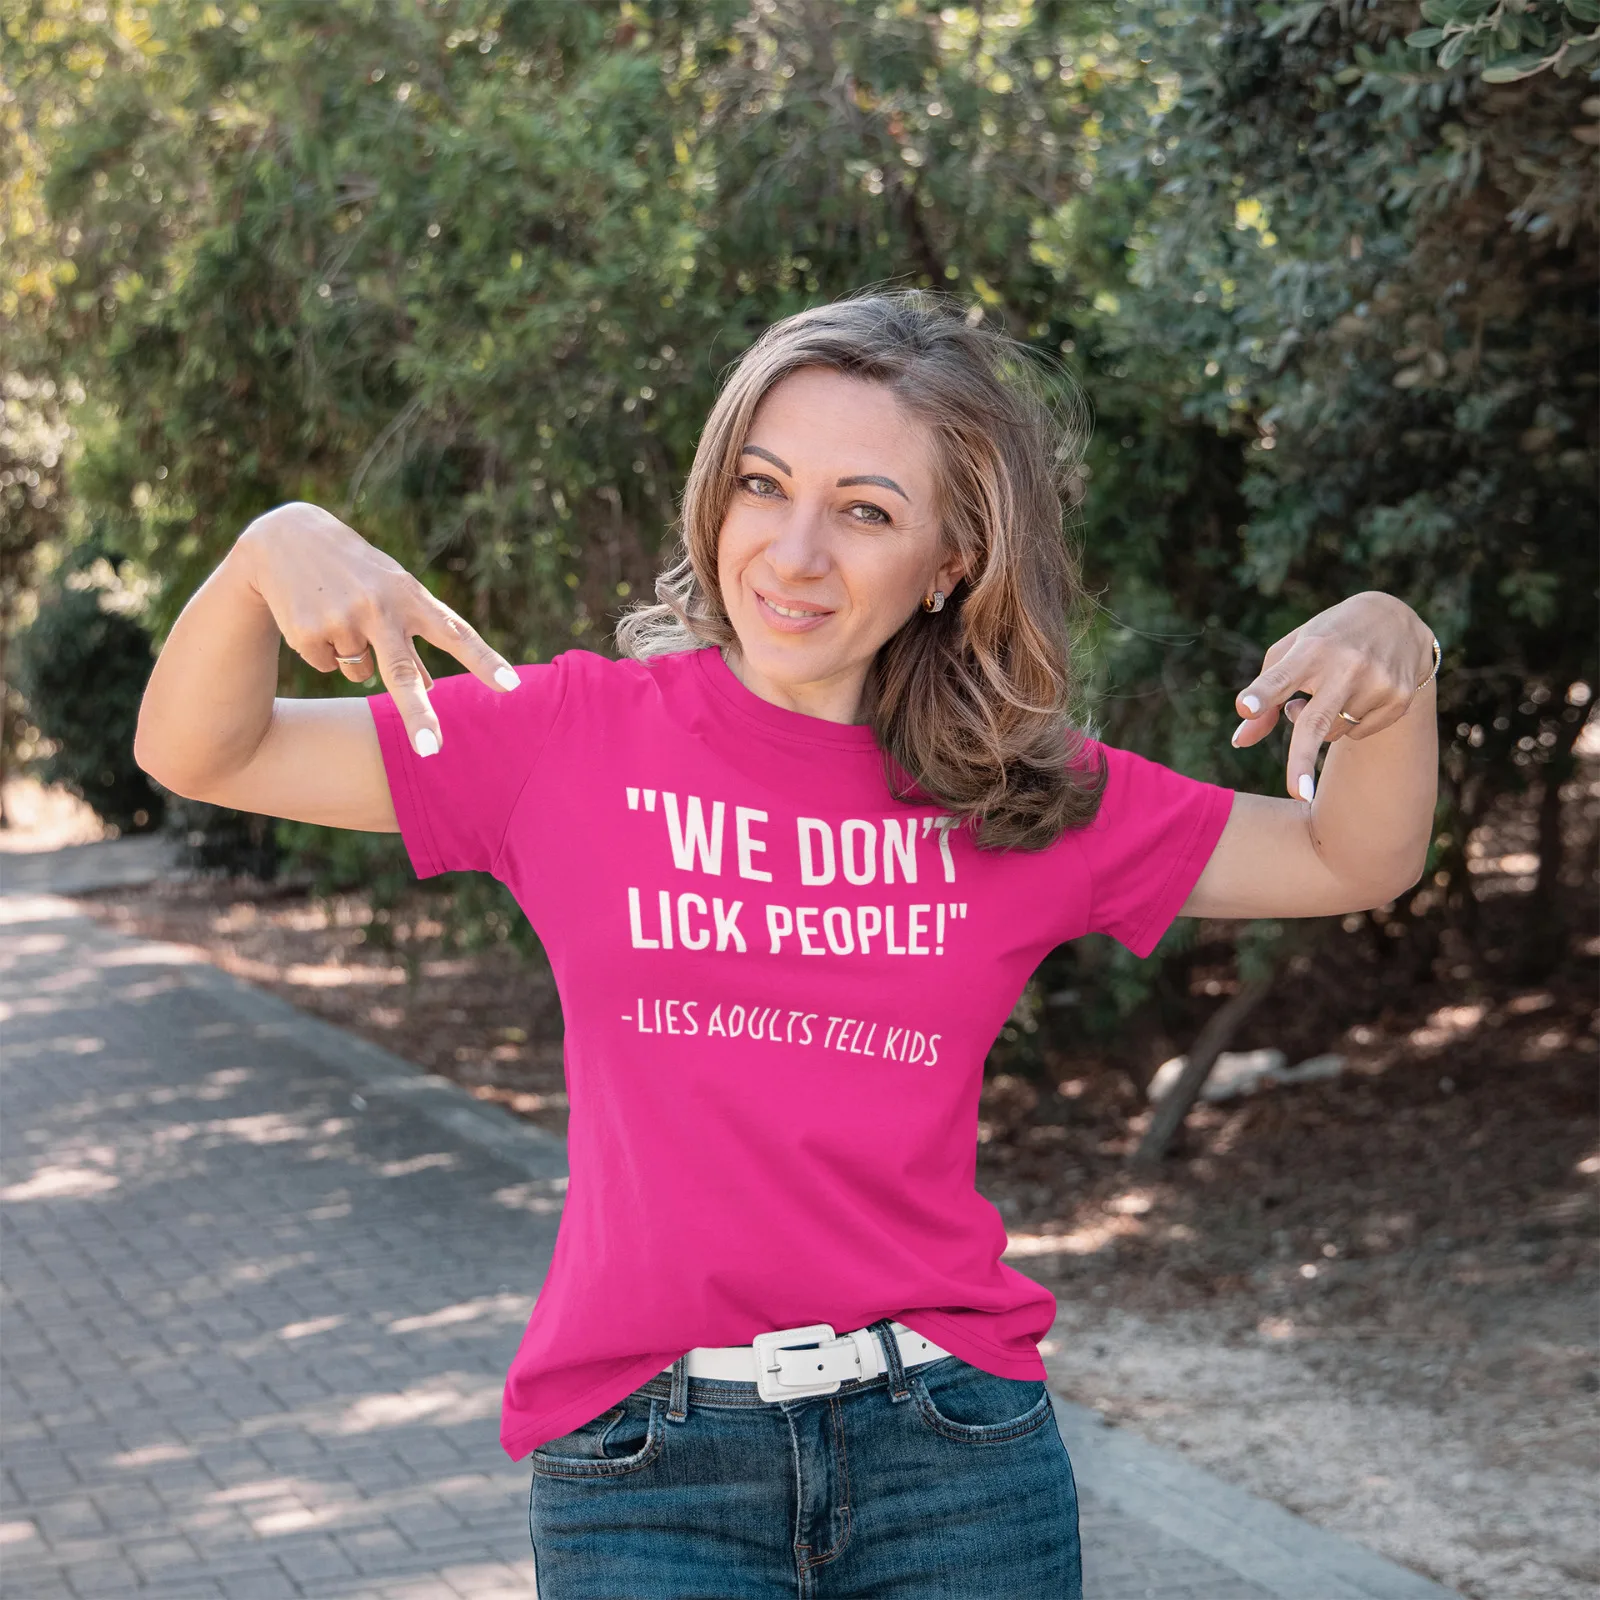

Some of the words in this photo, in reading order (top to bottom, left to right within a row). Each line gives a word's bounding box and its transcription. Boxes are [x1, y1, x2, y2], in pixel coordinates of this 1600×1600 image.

[625, 786, 773, 883] "WE
[796, 816, 961, 886] DON'T
[627, 886, 747, 953] LICK
[765, 902, 968, 956] PEOPLE!"
[621, 998, 699, 1036] -LIES
[707, 1004, 819, 1046] ADULTS
[823, 1016, 877, 1057] TELL
[882, 1026, 942, 1067] KIDS
